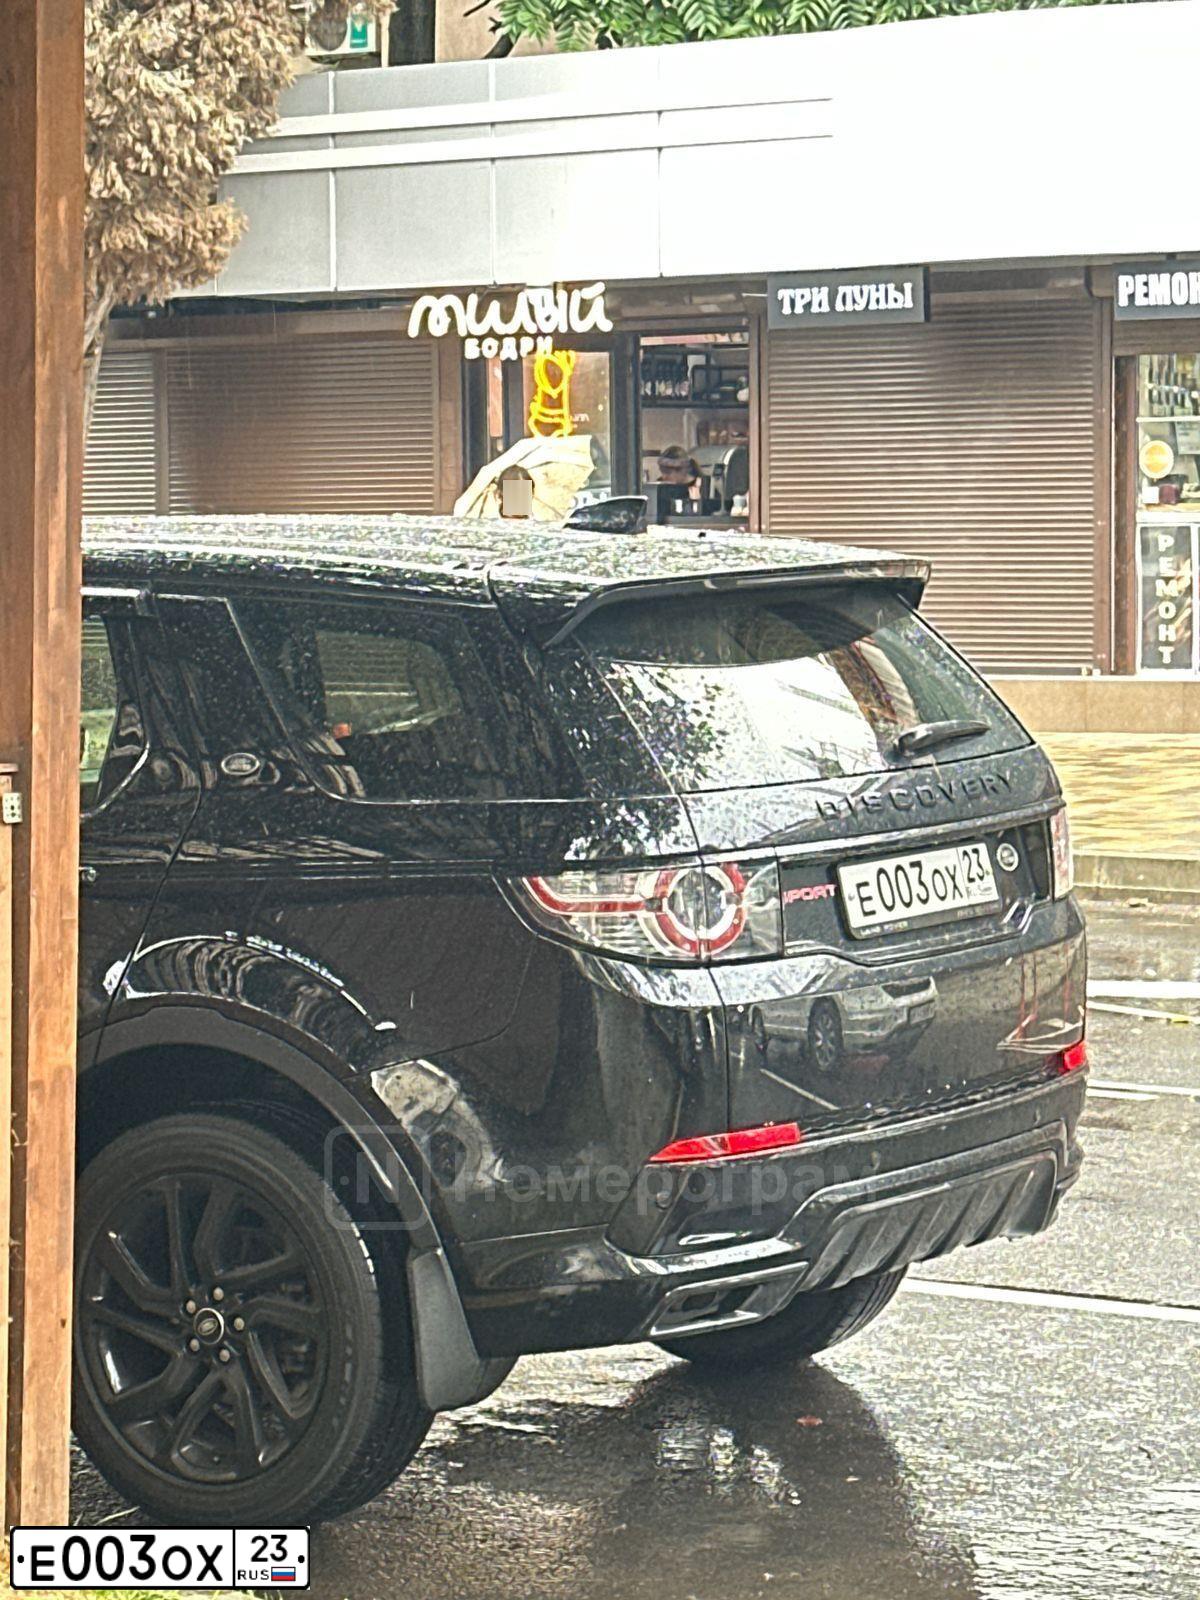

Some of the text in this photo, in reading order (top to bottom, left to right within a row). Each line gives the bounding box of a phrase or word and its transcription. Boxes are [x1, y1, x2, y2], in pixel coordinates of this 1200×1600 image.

[777, 282, 913, 315] ТРИ ЛУНЫ
[1155, 533, 1179, 664] РЕМОНТ
[814, 771, 1012, 819] DISCOVERY
[962, 848, 985, 883] 23
